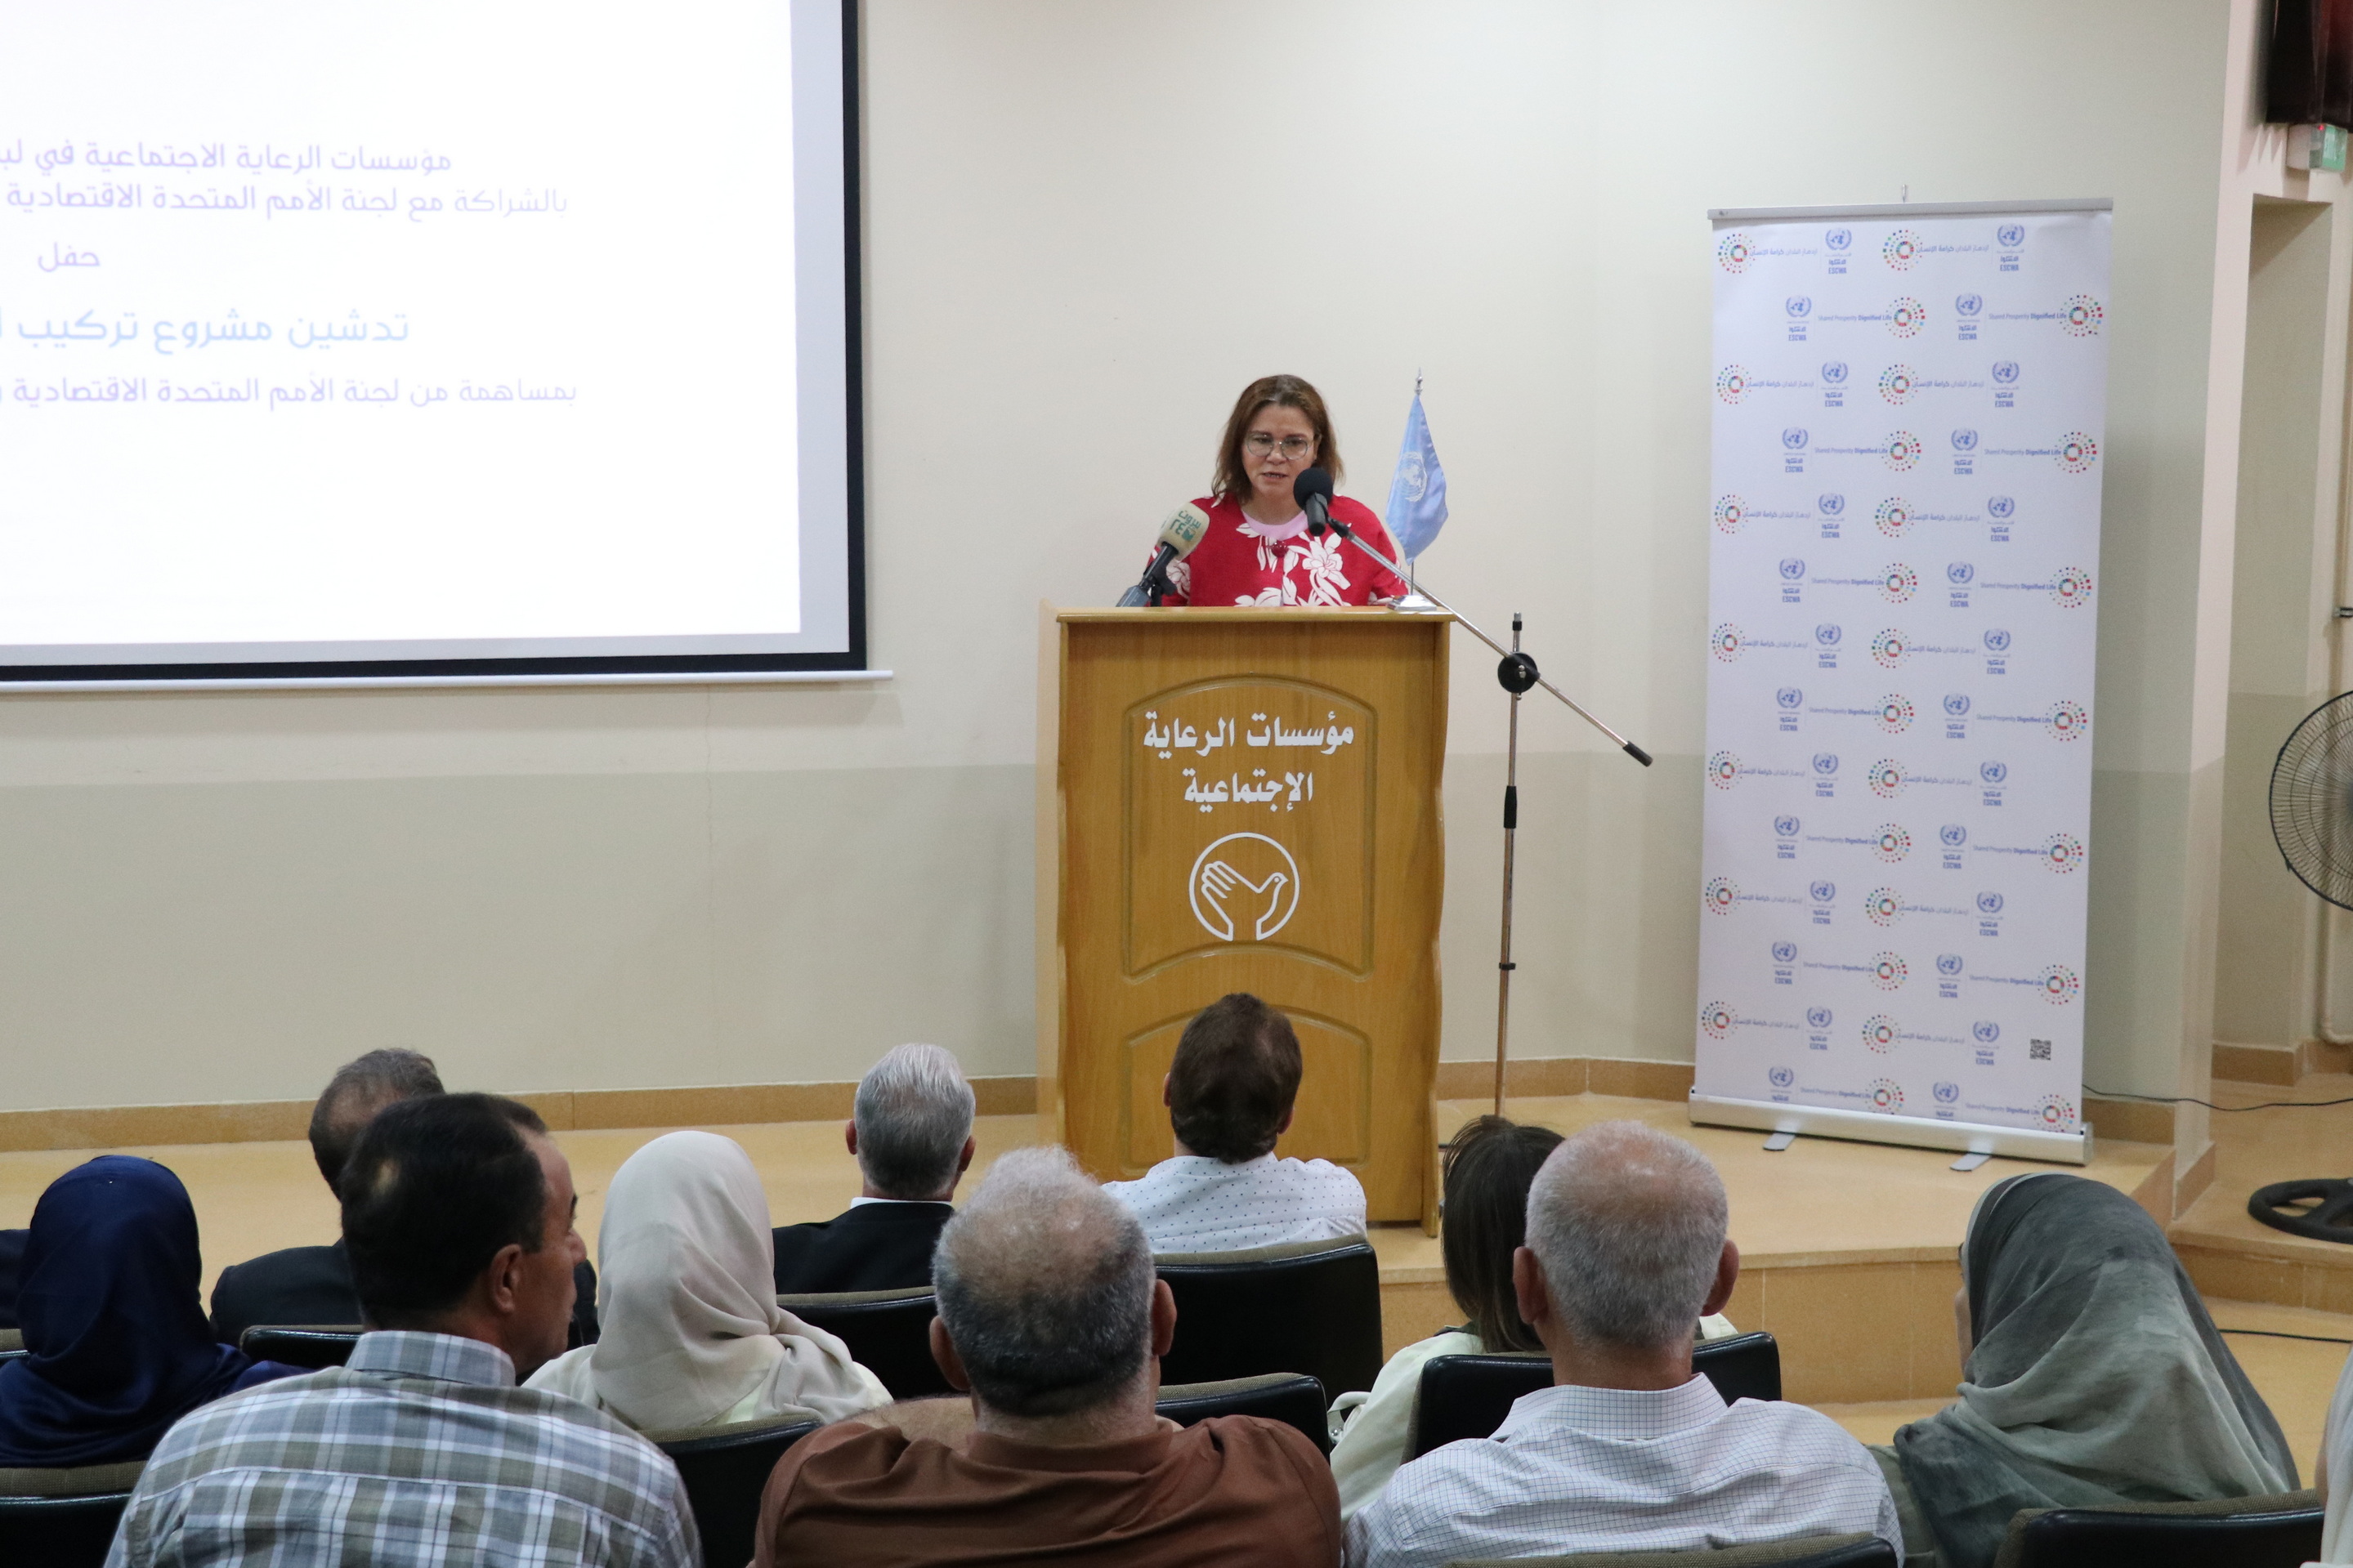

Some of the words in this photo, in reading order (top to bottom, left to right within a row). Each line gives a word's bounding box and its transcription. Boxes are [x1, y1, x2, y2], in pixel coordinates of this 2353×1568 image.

[34, 138, 75, 176] في
[84, 141, 226, 174] الاجتماعية
[235, 144, 322, 175] الرعاية
[330, 145, 453, 176] مؤسسات
[6, 181, 142, 213] الاقتصادية
[152, 185, 261, 211] المتحدة
[266, 179, 332, 221] الأمم
[341, 188, 398, 217] لجنة
[408, 197, 443, 223] مع
[454, 188, 567, 217] بالشراكة
[37, 241, 102, 273] حفل
[16, 308, 140, 349] تركيب
[152, 308, 274, 355] مشروع
[287, 308, 409, 350] تدشين
[12, 376, 148, 409] الاقتصادية
[156, 377, 261, 403] المتحدة
[268, 372, 335, 412] الأمم
[342, 378, 399, 407] لجنة
[409, 383, 449, 409] من
[459, 378, 577, 407] بمساهمة
[1143, 711, 1235, 759] الرعاية
[1246, 711, 1354, 755] مؤسسات
[1182, 768, 1313, 813] الإجتماعية
